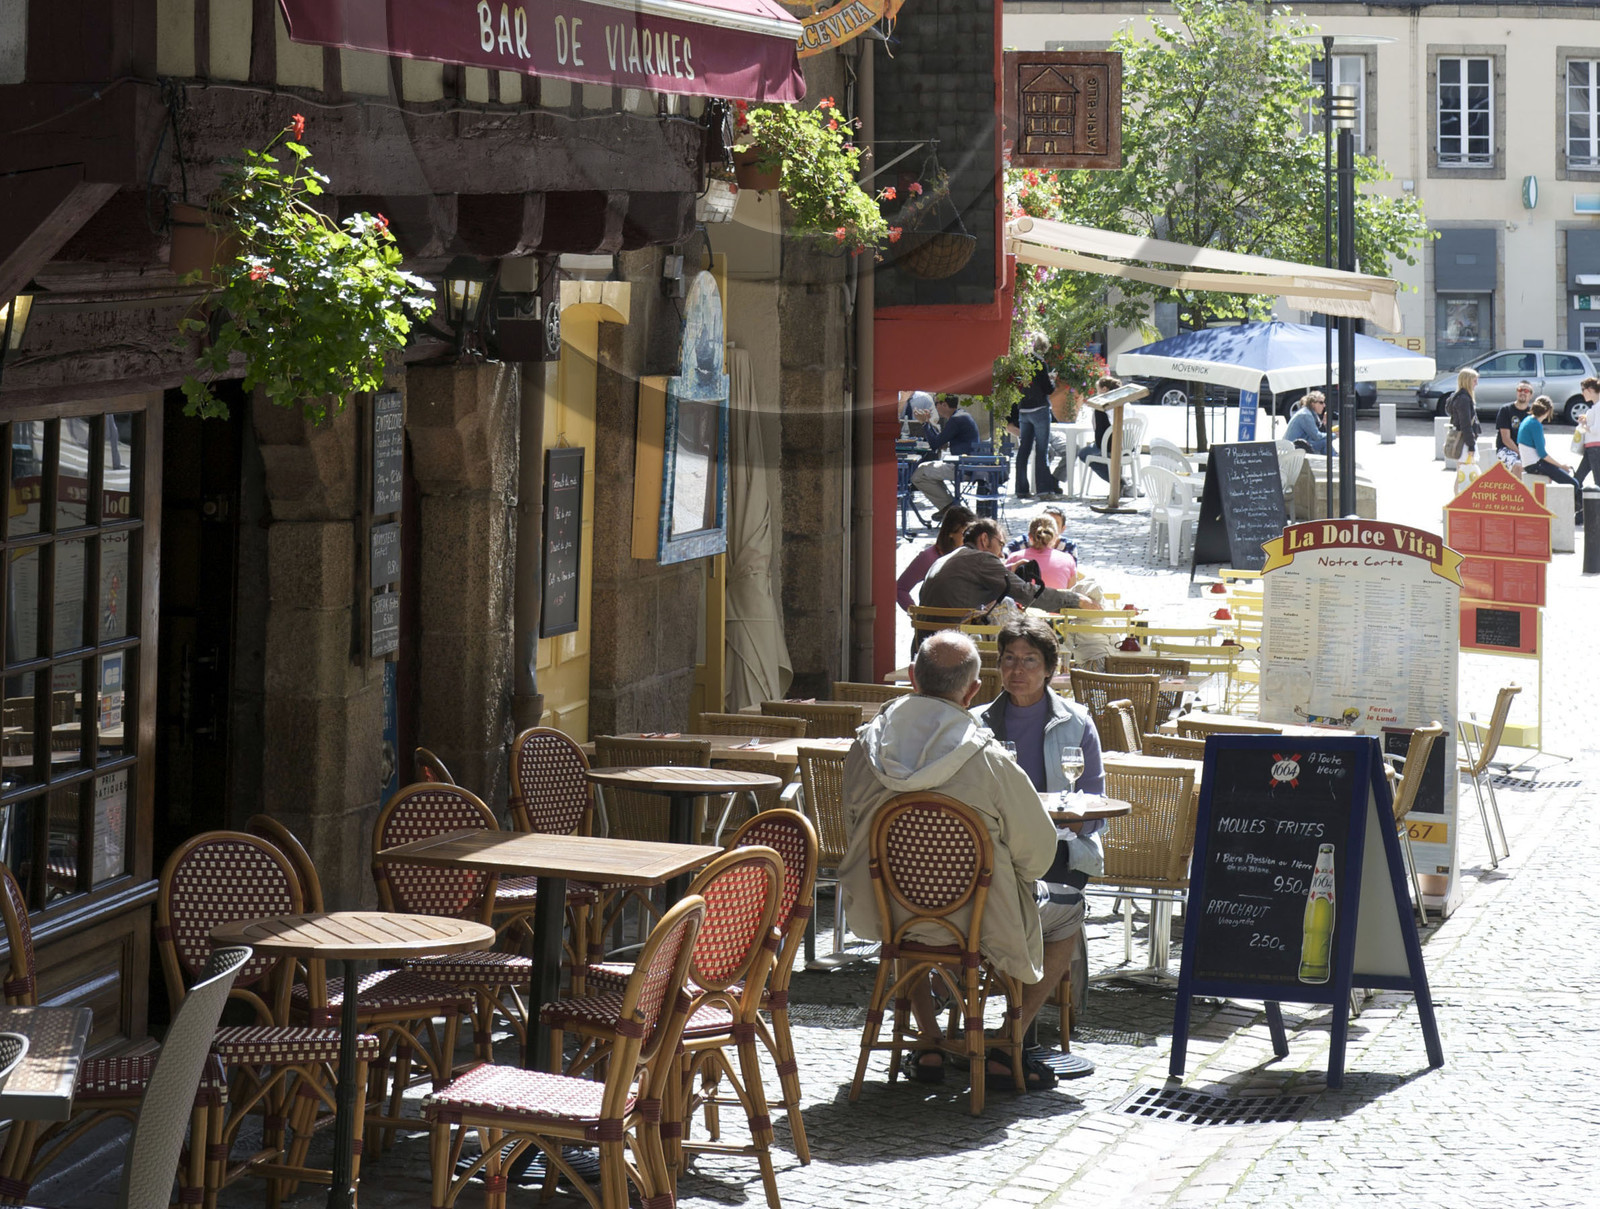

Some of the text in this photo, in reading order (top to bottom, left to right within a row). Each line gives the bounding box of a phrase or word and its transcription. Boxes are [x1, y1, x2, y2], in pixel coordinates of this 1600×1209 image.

[476, 0, 695, 81] BAR DE VIARMES
[1472, 491, 1525, 503] ATIPIK BILIG
[1289, 529, 1314, 550] La
[1322, 523, 1385, 546] Dolce
[1392, 528, 1437, 559] Vita
[1318, 556, 1403, 567] Notre Carte
[1379, 715, 1398, 723] Lundi
[1272, 762, 1298, 777] 1664
[1217, 817, 1325, 838] MOULES FRITES
[1206, 899, 1271, 918] ARTICHAUT
